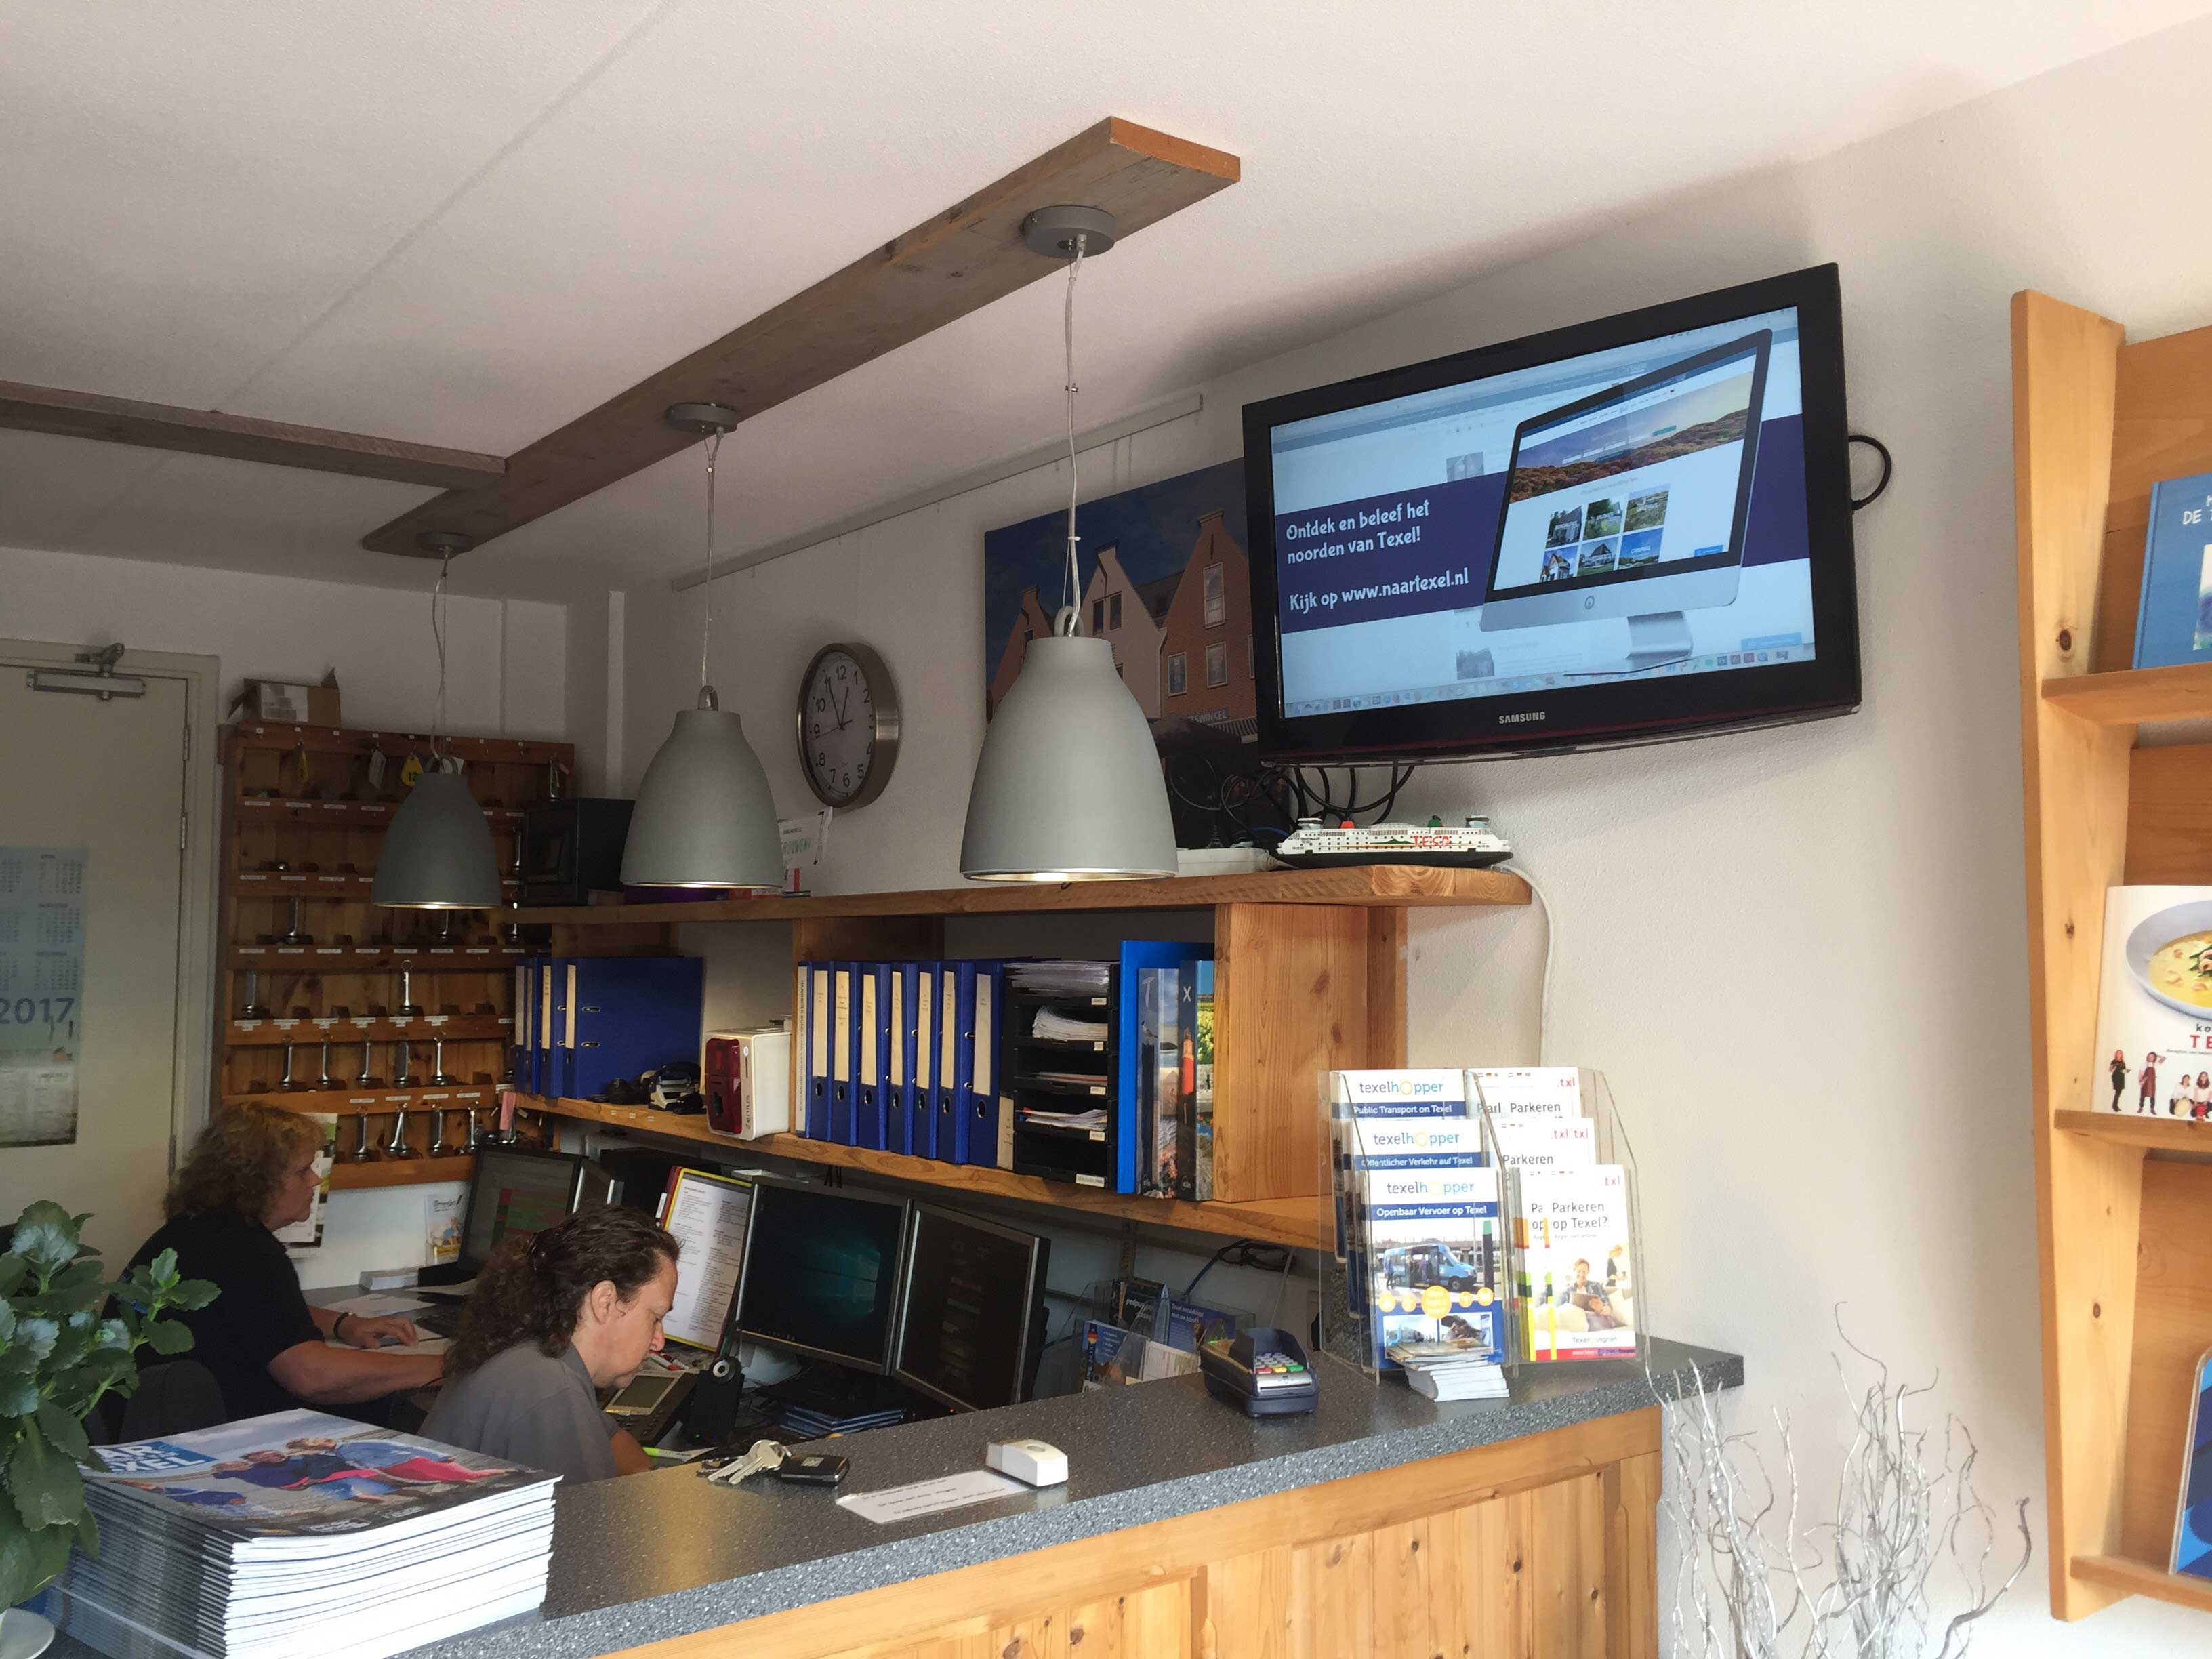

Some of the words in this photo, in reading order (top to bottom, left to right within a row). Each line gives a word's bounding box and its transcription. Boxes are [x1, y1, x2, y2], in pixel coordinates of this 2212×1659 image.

[1287, 518, 1335, 540] Ontdek
[1338, 518, 1355, 531] en
[1359, 503, 1402, 529] beleef
[1406, 499, 1429, 519] het
[2183, 509, 2203, 525] DE
[1288, 542, 1344, 564] noorden
[1348, 539, 1374, 554] van
[1377, 525, 1420, 548] Texel!
[1290, 592, 1317, 614] Kijk
[1321, 592, 1338, 609] op
[1342, 567, 1469, 602] www.naartexel.nl
[836, 665, 846, 680] 12
[816, 698, 825, 714] 10
[1498, 711, 1545, 724] SAMSUNG
[814, 724, 820, 739] 9
[819, 752, 825, 766] 8
[830, 769, 836, 783] 7
[843, 773, 850, 787] 6
[1183, 986, 1191, 1002] X
[0, 998, 75, 1025] 2017
[2196, 1023, 2211, 1032] ko
[1359, 1080, 1443, 1095] texelhopper
[1355, 1106, 1378, 1115] Public
[1379, 1105, 1418, 1115] Transport
[1431, 1105, 1452, 1113] Texel
[1510, 1102, 1561, 1113] Parkeren
[1374, 1130, 1460, 1147] texelhopper
[1408, 1158, 1437, 1166] Verkehr
[1439, 1156, 1452, 1165] auf
[1452, 1156, 1473, 1165] Texel
[1502, 1154, 1554, 1165] Parkeren
[1387, 1181, 1474, 1195] texelhopper
[1376, 1208, 1416, 1217] Openbaar
[1418, 1206, 1450, 1215] Vervoer
[1452, 1207, 1463, 1215] op
[1465, 1206, 1487, 1214] Texel
[1552, 1202, 1605, 1213] Parkeren
[1553, 1220, 1568, 1231] op
[1570, 1216, 1608, 1228] Texel?
